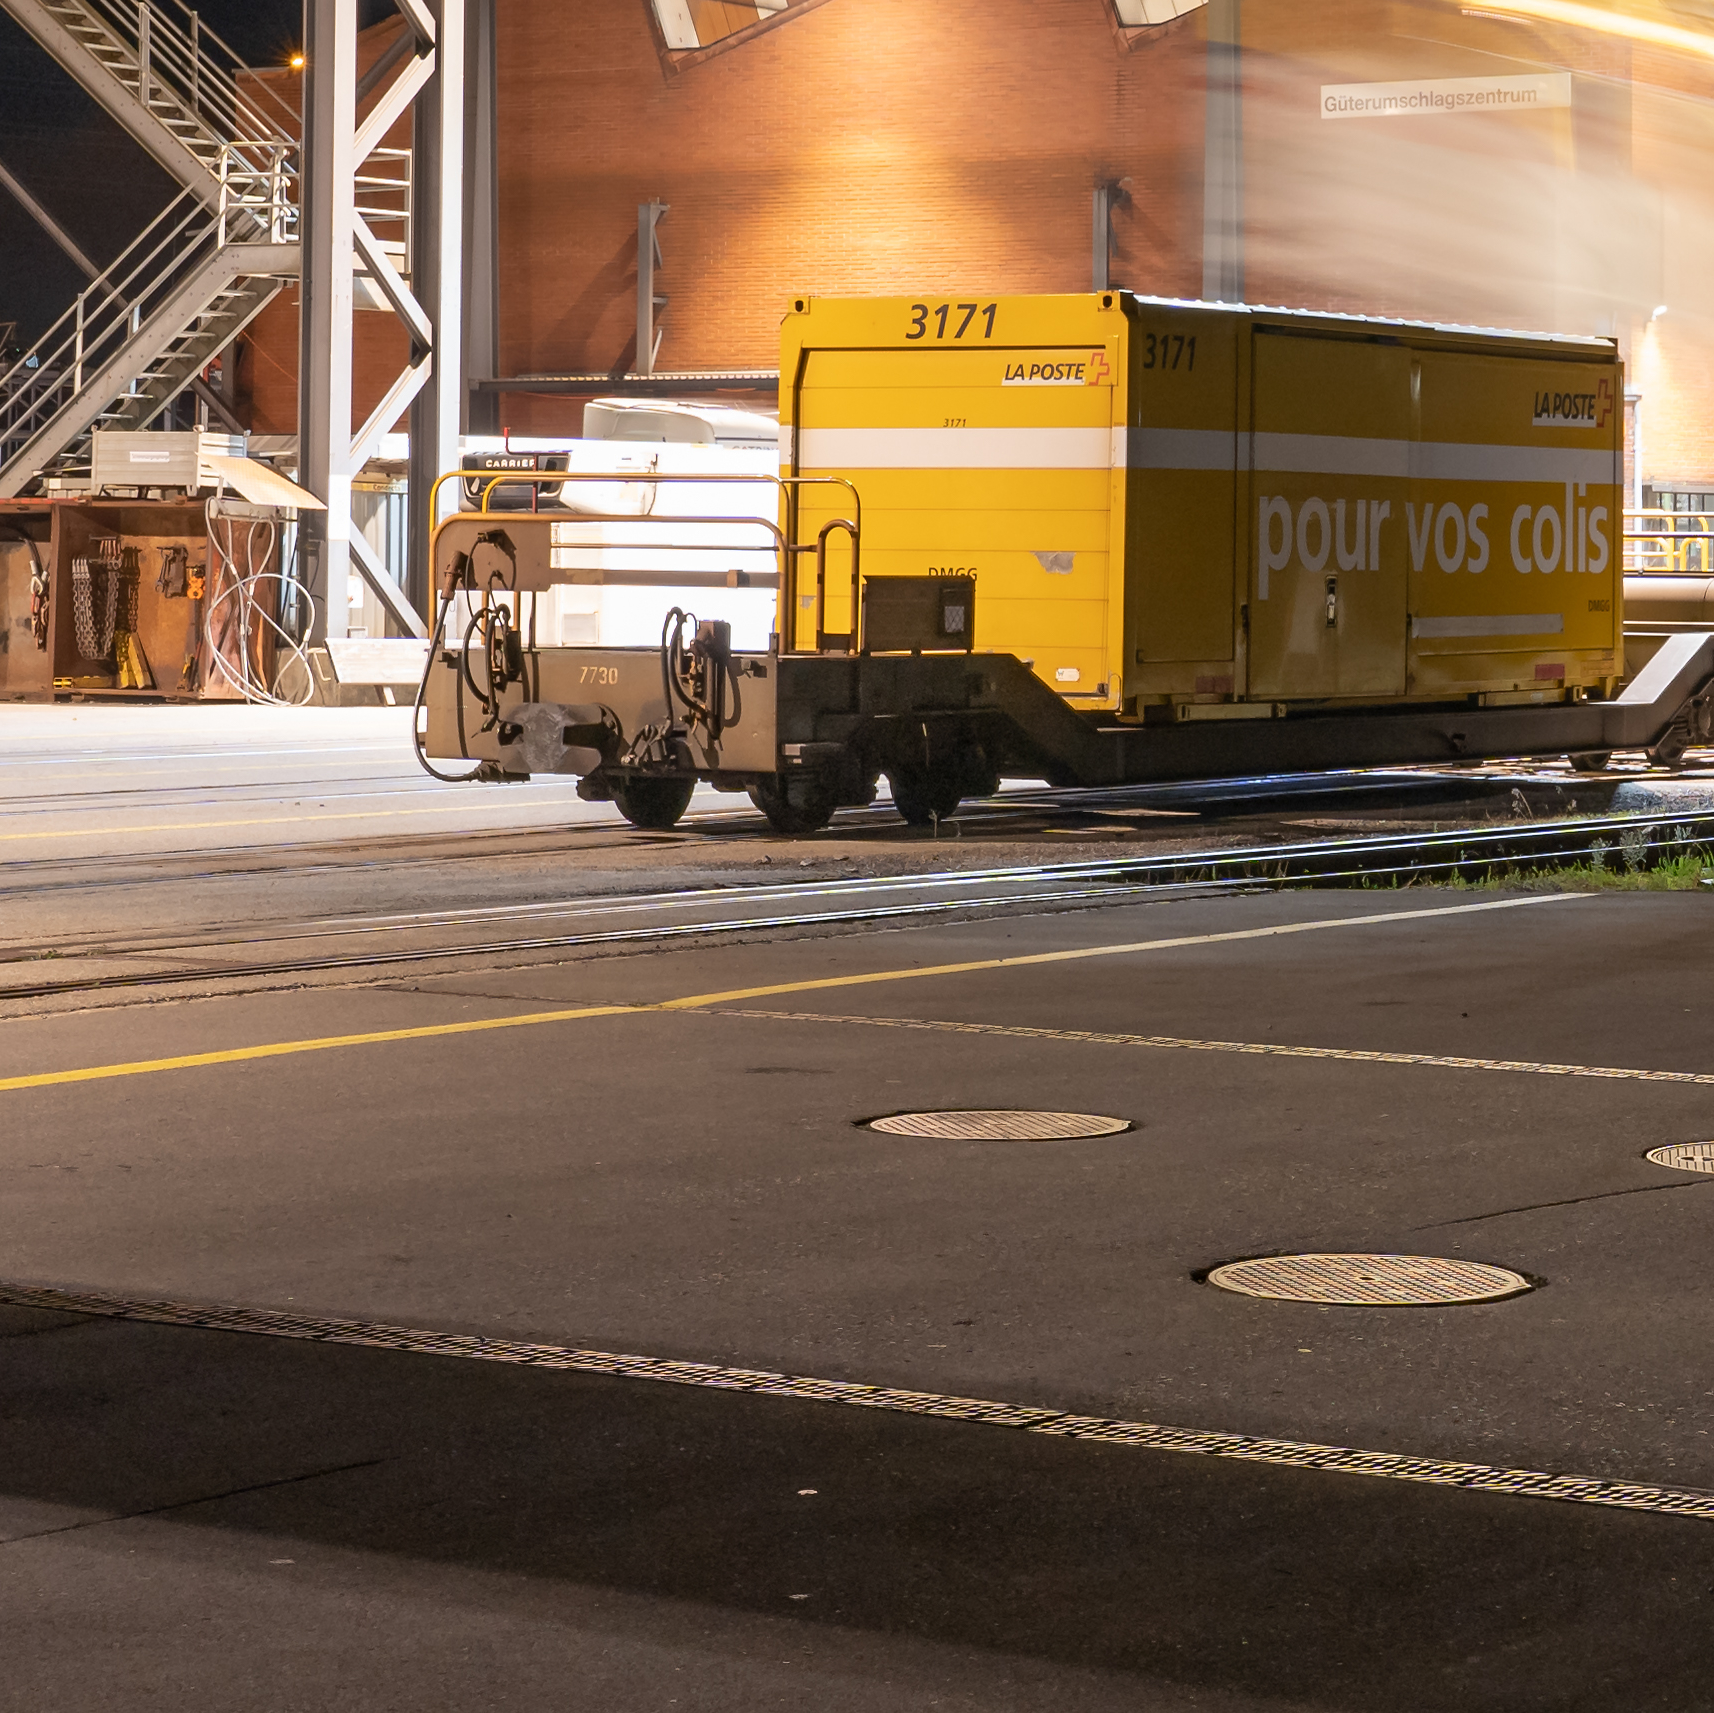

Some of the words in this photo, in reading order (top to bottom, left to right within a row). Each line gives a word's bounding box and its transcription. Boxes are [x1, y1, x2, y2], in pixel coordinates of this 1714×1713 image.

[1324, 88, 1537, 113] Güterumschlagszentrum
[905, 303, 998, 340] 3171
[1143, 332, 1197, 372] 3171
[1004, 363, 1025, 381] LA
[1029, 363, 1086, 381] POSTE
[1534, 391, 1550, 418] LA
[1552, 392, 1596, 420] POSTE
[943, 418, 967, 428] 3171
[1258, 495, 1391, 601] pour
[1405, 501, 1490, 574] vos
[1510, 480, 1610, 574] colis
[579, 666, 619, 685] 7730
